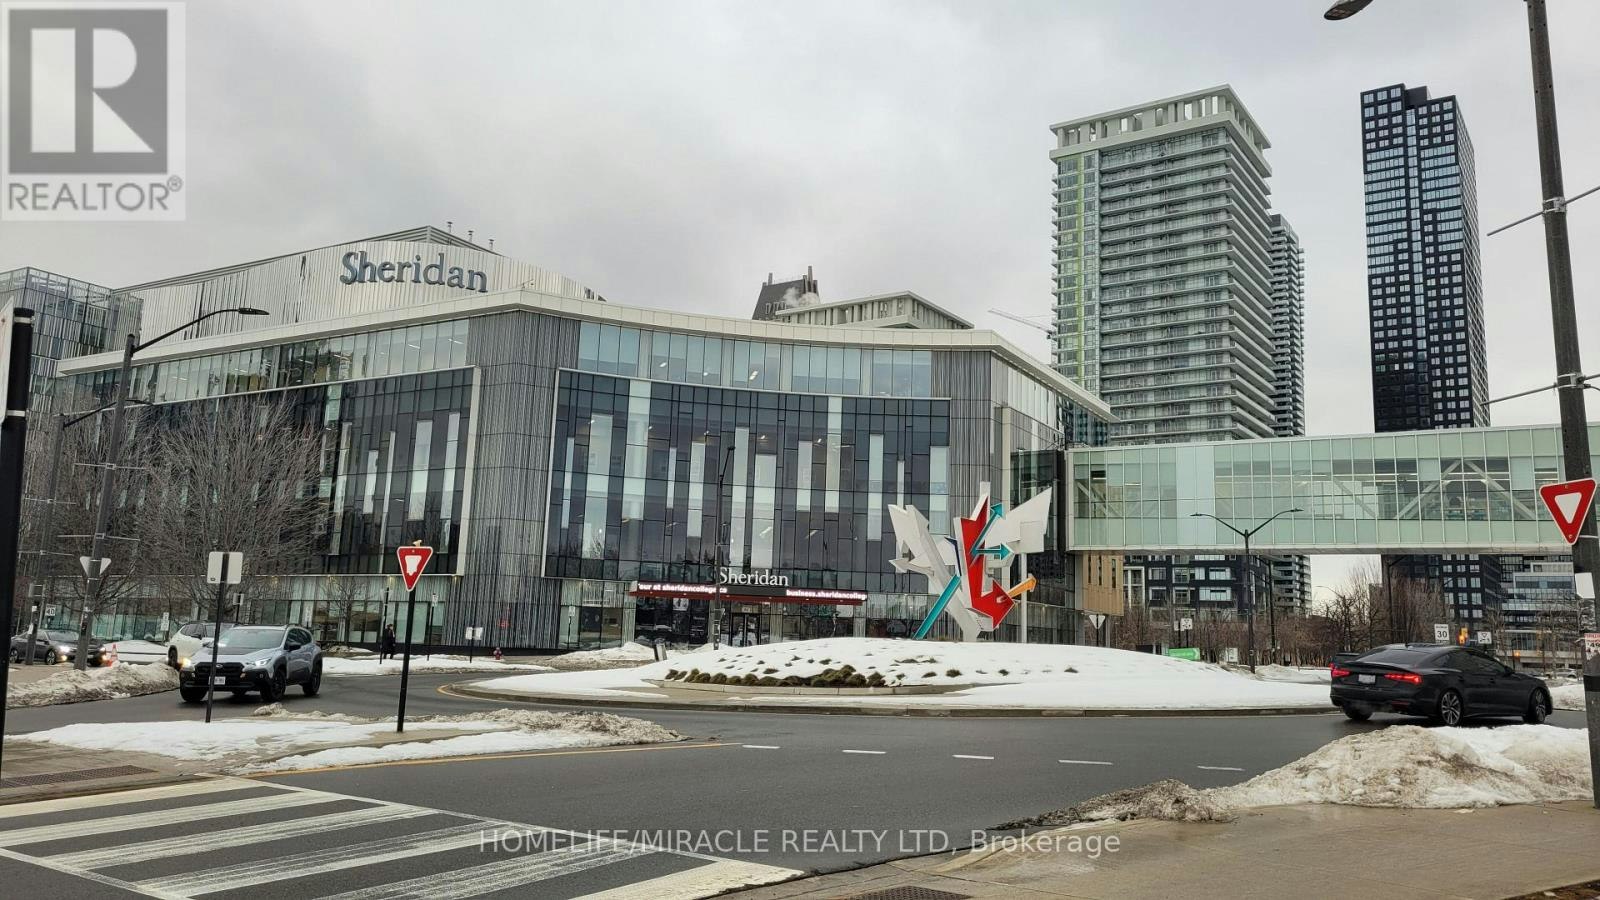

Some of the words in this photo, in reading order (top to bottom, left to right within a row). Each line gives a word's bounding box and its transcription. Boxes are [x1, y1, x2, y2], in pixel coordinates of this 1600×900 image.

[339, 250, 488, 293] Sheridan
[719, 566, 789, 587] Sheridan
[786, 589, 868, 600] business.sheridancolleg
[1436, 630, 1447, 638] 30
